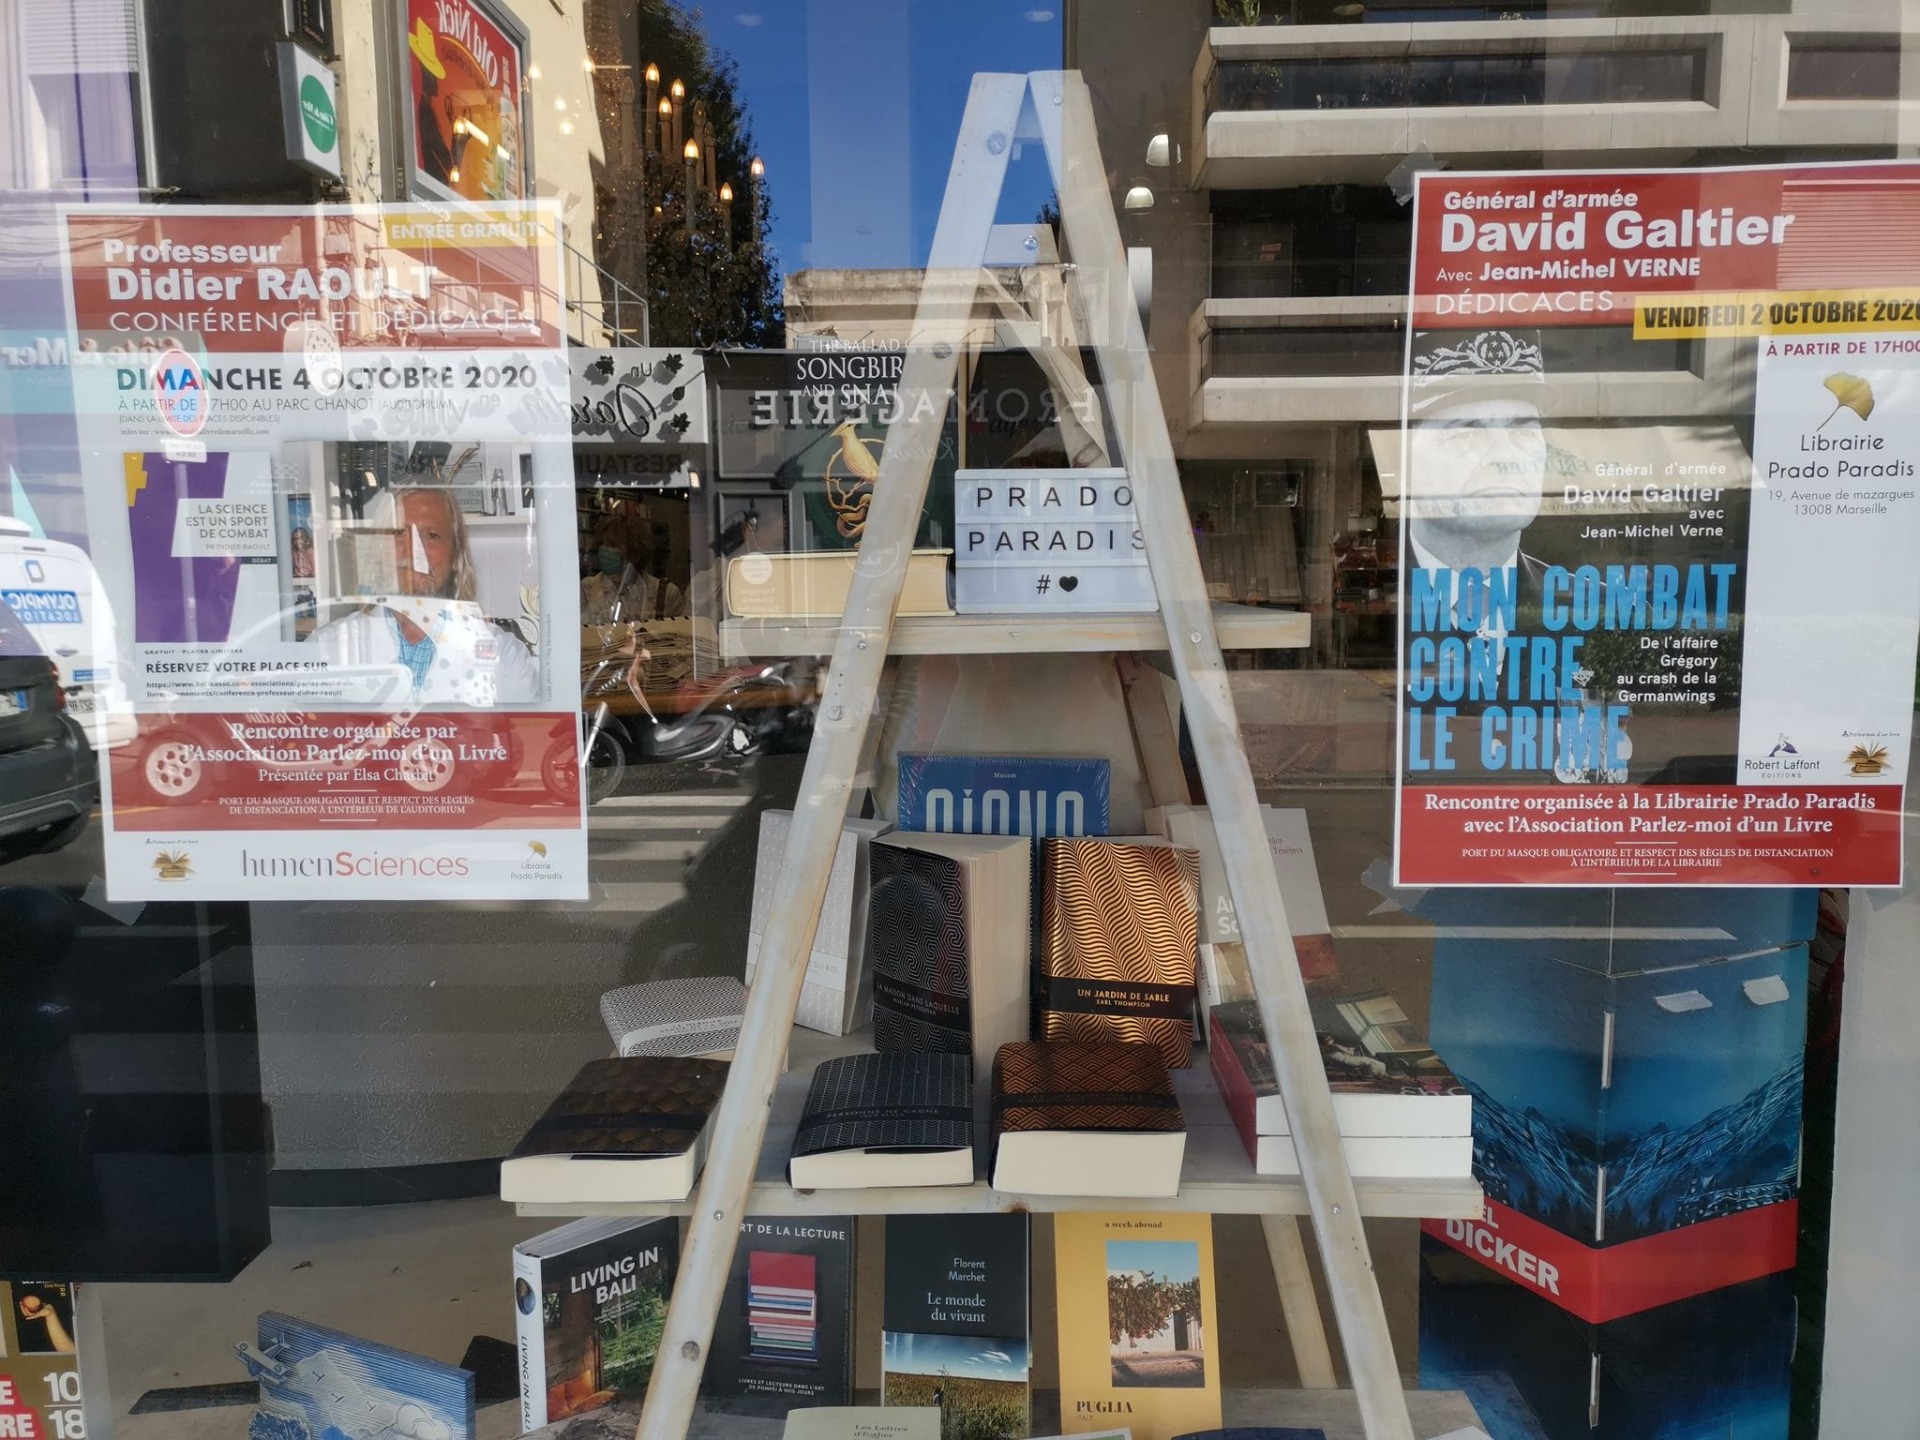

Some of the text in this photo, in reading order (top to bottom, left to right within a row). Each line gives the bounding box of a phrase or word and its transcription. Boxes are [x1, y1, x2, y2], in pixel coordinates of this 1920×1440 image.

[1444, 189, 1638, 210] Général d'armée
[1440, 207, 1795, 252] David Galtier
[102, 239, 282, 264] Professeur
[1436, 258, 1701, 282] Avec Jean-Michel VERNE
[109, 265, 438, 301] Didier RAOULT
[1436, 288, 1613, 315] DÉDICACES
[110, 306, 536, 332] CONFÉRENCE ET DÉDICACES
[1643, 302, 1867, 329] VENDREDI 2 OCTOBRE
[843, 338, 900, 352] BALLAD
[1767, 340, 1867, 356] À PARTIR DE
[796, 356, 903, 380] SONGBIR
[116, 365, 537, 391] DIMANCHE 4 OCTOBRE 2020
[803, 384, 835, 398] AND
[133, 398, 310, 411] PARTIR DE AU PARC
[1801, 434, 1884, 451] Librairie
[1595, 462, 1726, 476] Général d'armée
[1769, 460, 1914, 479] Prado Paradis
[976, 486, 1133, 508] PRADO
[1564, 484, 1725, 504] David Galtier
[1791, 489, 1915, 502] Avenue de mazargues
[198, 504, 267, 514] LA SCIENCE
[1689, 508, 1724, 519] avec
[1795, 503, 1888, 515] 13008 Marseille
[186, 516, 268, 526] EST UN SPORT
[200, 529, 269, 538] DE COMBAT
[1581, 524, 1723, 539] Jean-Michel Verne
[1410, 564, 1737, 633] MON COMBAT
[1640, 635, 1718, 649] De l'affaire
[146, 660, 329, 673] RÉSERVEZ VOTRE PLACE SUR
[1410, 636, 1585, 702] CONTRE
[1660, 653, 1718, 670] Grégory
[1617, 672, 1717, 685] au crash de la
[1618, 690, 1716, 703] Germanwings
[231, 721, 457, 747] Rencontre organisée par
[1409, 705, 1631, 771] LE CRIME
[183, 744, 507, 762] l'Association Parlez-moi Livre
[1744, 759, 1820, 770] Robert Laffont
[258, 768, 381, 785] Présentée par Elsa
[262, 796, 417, 806] MASQUE RESPECT
[1424, 792, 1876, 815] Rencontre organisée à la Librairie Prado Paradis
[1464, 815, 1833, 834] avec l'Association Parlez-moi d'un Livre
[1462, 846, 1834, 858] PORT DU MASQUE OBLIGATOIRE RESPECT DES RÈGLES DISTANCIATION
[1673, 858, 1722, 867] LIBRAIRIE
[1077, 989, 1170, 1002] UN JARDIN DE SABLE
[1097, 999, 1150, 1008] EARL THOMPSON
[757, 1225, 846, 1241] DE LA LECTURE
[1112, 1221, 1163, 1229] week abroad
[953, 1257, 986, 1269] Florent
[1446, 1218, 1560, 1297] DICKER
[570, 1246, 659, 1294] LIVING IN
[949, 1271, 986, 1282] Marchet
[596, 1274, 637, 1305] BALI
[927, 1292, 986, 1307] Le monde
[931, 1309, 986, 1323] du vivant
[43, 1371, 81, 1402] 10
[521, 1335, 532, 1430] LIVING BALI
[766, 1380, 793, 1388] LECTEURS
[1076, 1400, 1133, 1413] PUGLIA
[48, 1409, 86, 1440] 18
[999, 1431, 1017, 1439] Stock
